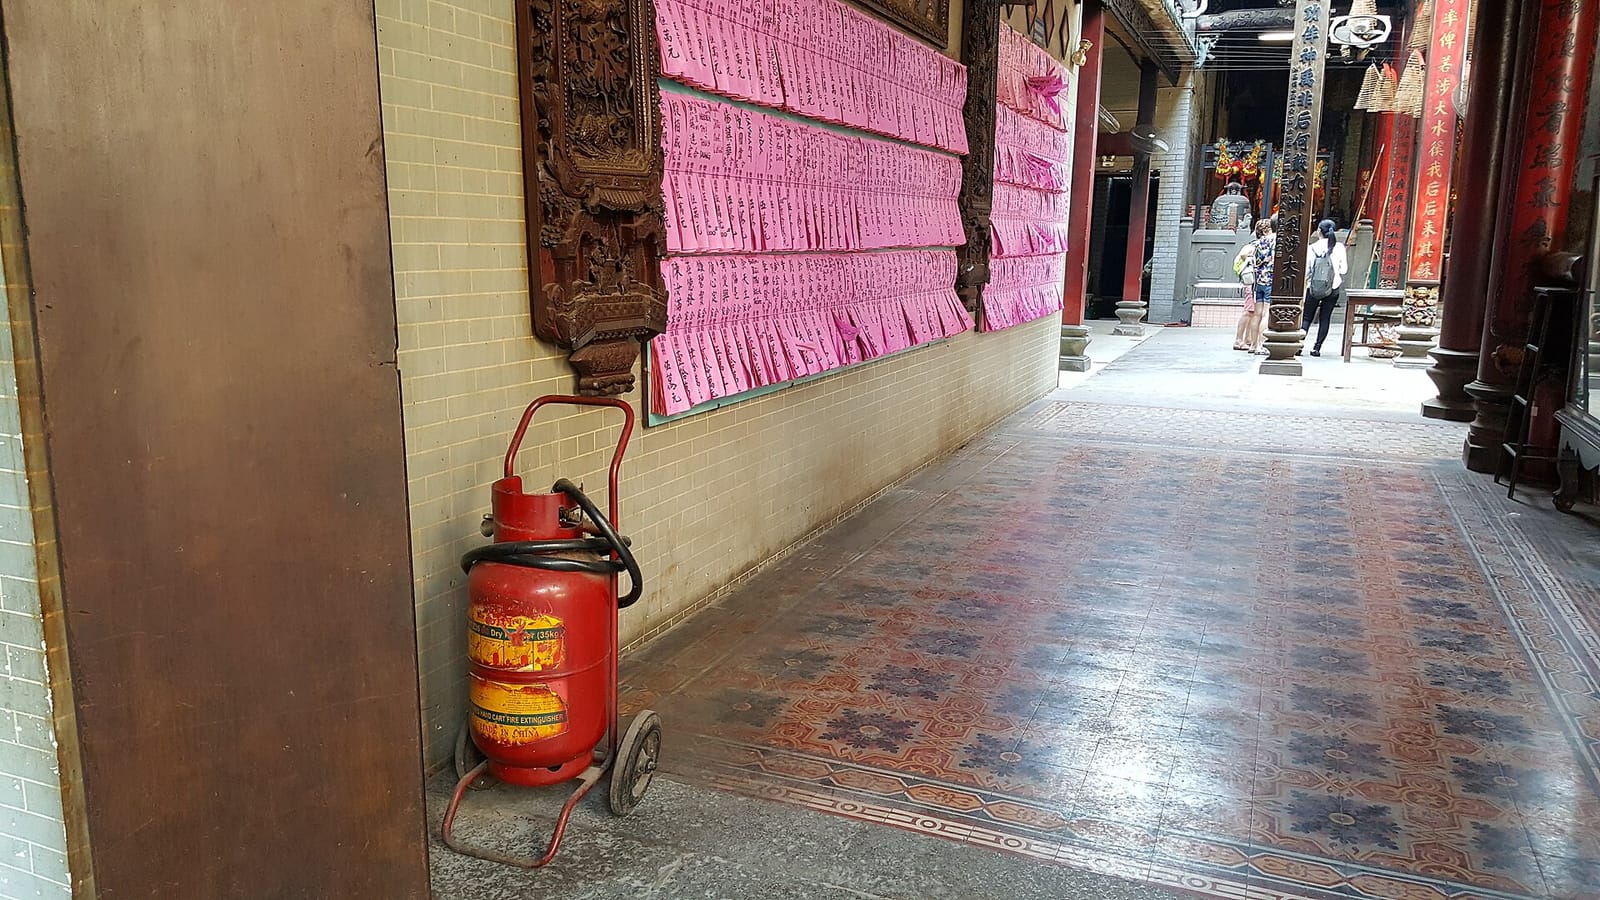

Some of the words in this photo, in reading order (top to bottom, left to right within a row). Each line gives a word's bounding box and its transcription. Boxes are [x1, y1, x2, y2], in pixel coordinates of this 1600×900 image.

[490, 629, 503, 640] Dry
[492, 712, 507, 723] CART
[506, 715, 520, 725] FIRE
[511, 727, 540, 739] CHINA
